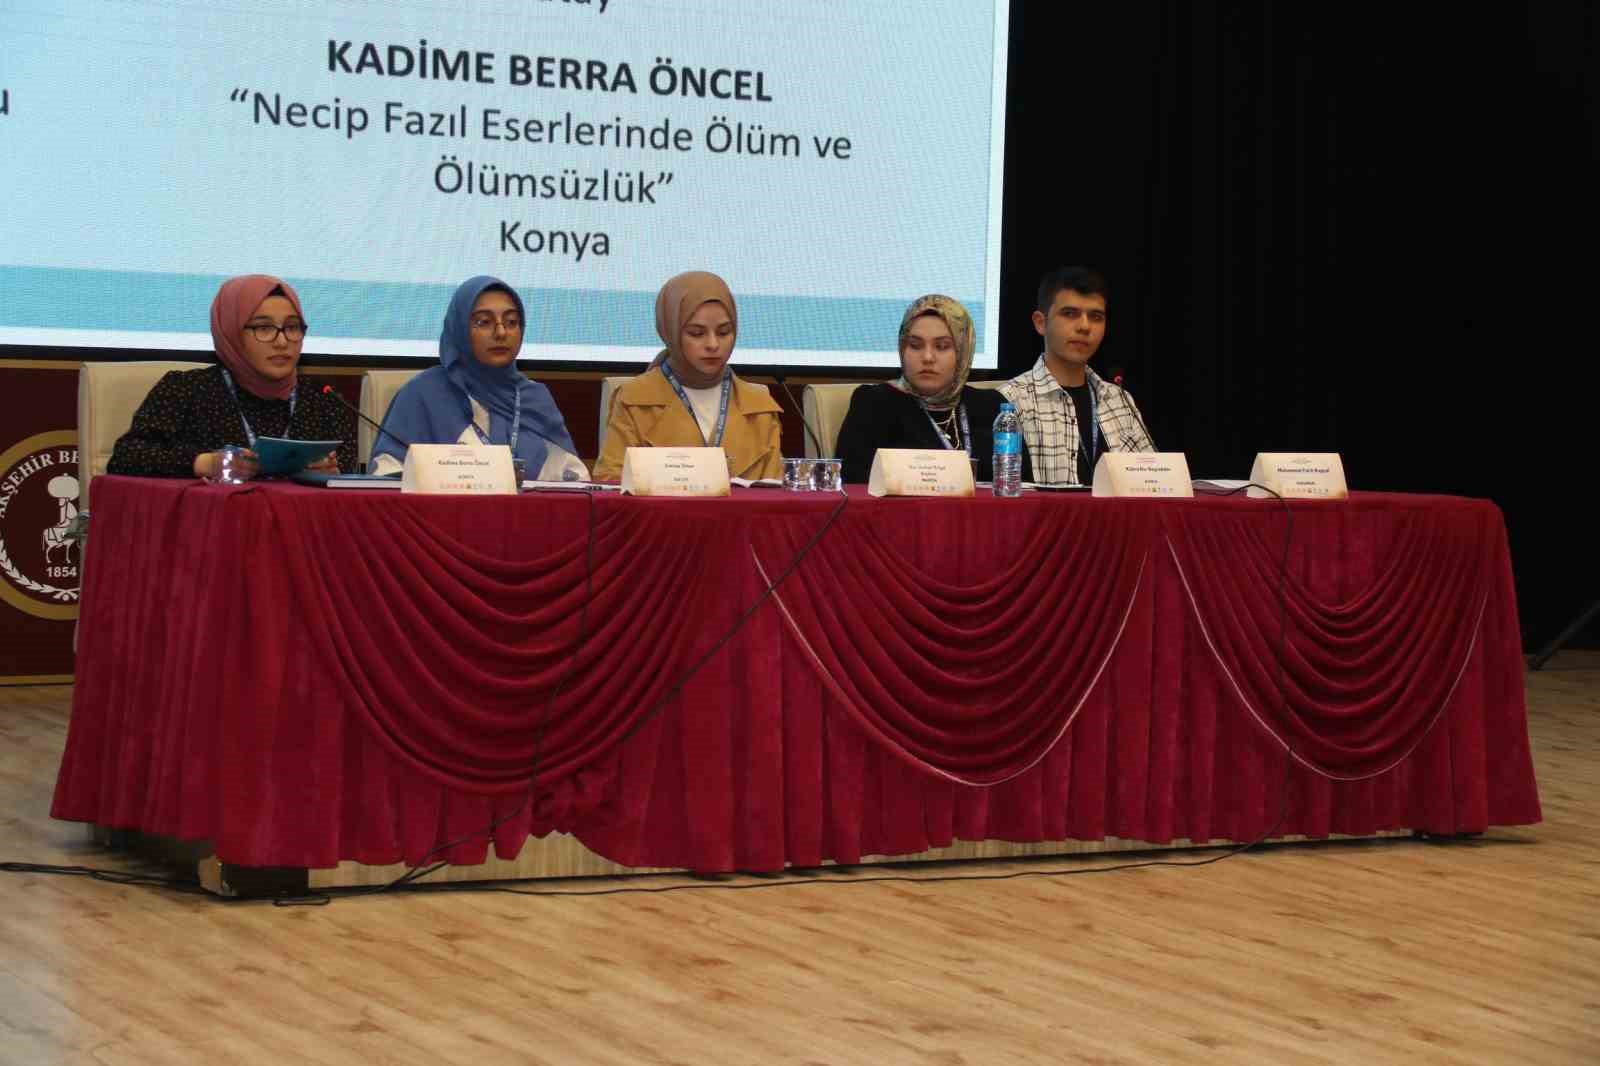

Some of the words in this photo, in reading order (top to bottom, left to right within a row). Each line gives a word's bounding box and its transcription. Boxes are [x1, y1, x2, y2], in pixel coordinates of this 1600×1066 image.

[327, 38, 496, 84] KADİME
[509, 55, 637, 93] BERRA
[649, 57, 773, 102] ÖNCEL
[230, 88, 369, 139] “Necip
[385, 102, 467, 138] Fazıl
[482, 108, 694, 152] Eserlerinde
[705, 116, 800, 157] Ölüm
[813, 135, 853, 160] ve
[434, 155, 674, 205] Ölümsüzlük”
[500, 221, 611, 262] Konya
[46, 566, 77, 577] 1854
